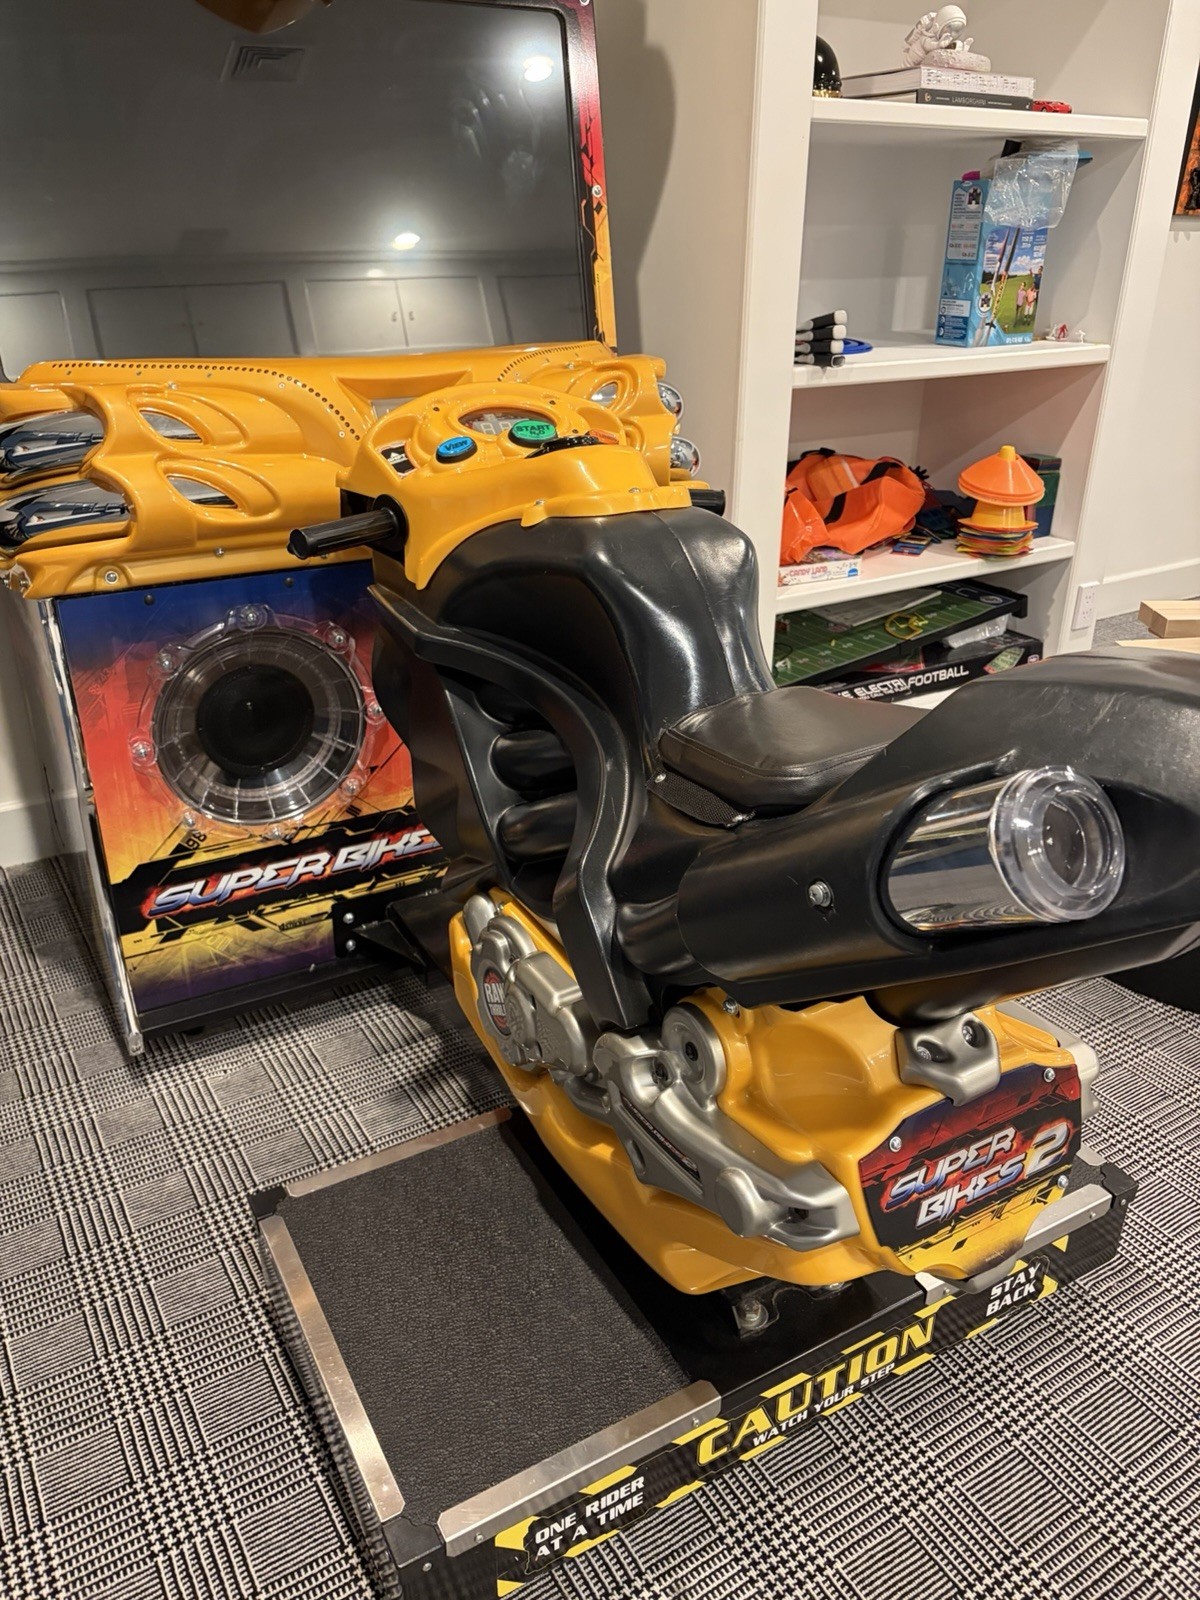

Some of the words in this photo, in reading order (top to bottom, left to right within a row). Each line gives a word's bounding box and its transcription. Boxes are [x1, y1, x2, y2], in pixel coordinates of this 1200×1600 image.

[515, 424, 550, 432] START
[789, 569, 811, 577] CANDY
[811, 565, 828, 575] LAND
[907, 665, 970, 690] FOOTBALL
[148, 850, 332, 918] SUPER
[332, 828, 443, 872] BIKE
[884, 1126, 1017, 1210] SUPER
[915, 1152, 1027, 1229] BIKES
[1024, 1122, 1070, 1180] 2
[985, 1279, 1036, 1317] BACK
[990, 1262, 1041, 1300] STAY
[697, 1314, 936, 1466] CAUTION
[752, 1411, 808, 1446] WATCH
[813, 1385, 855, 1413] YOUR
[859, 1362, 896, 1389] STEP
[534, 1534, 563, 1561] AT
[571, 1524, 588, 1541] A
[596, 1491, 644, 1526] TIME
[535, 1512, 577, 1544] ONE
[585, 1476, 645, 1518] RIDER
